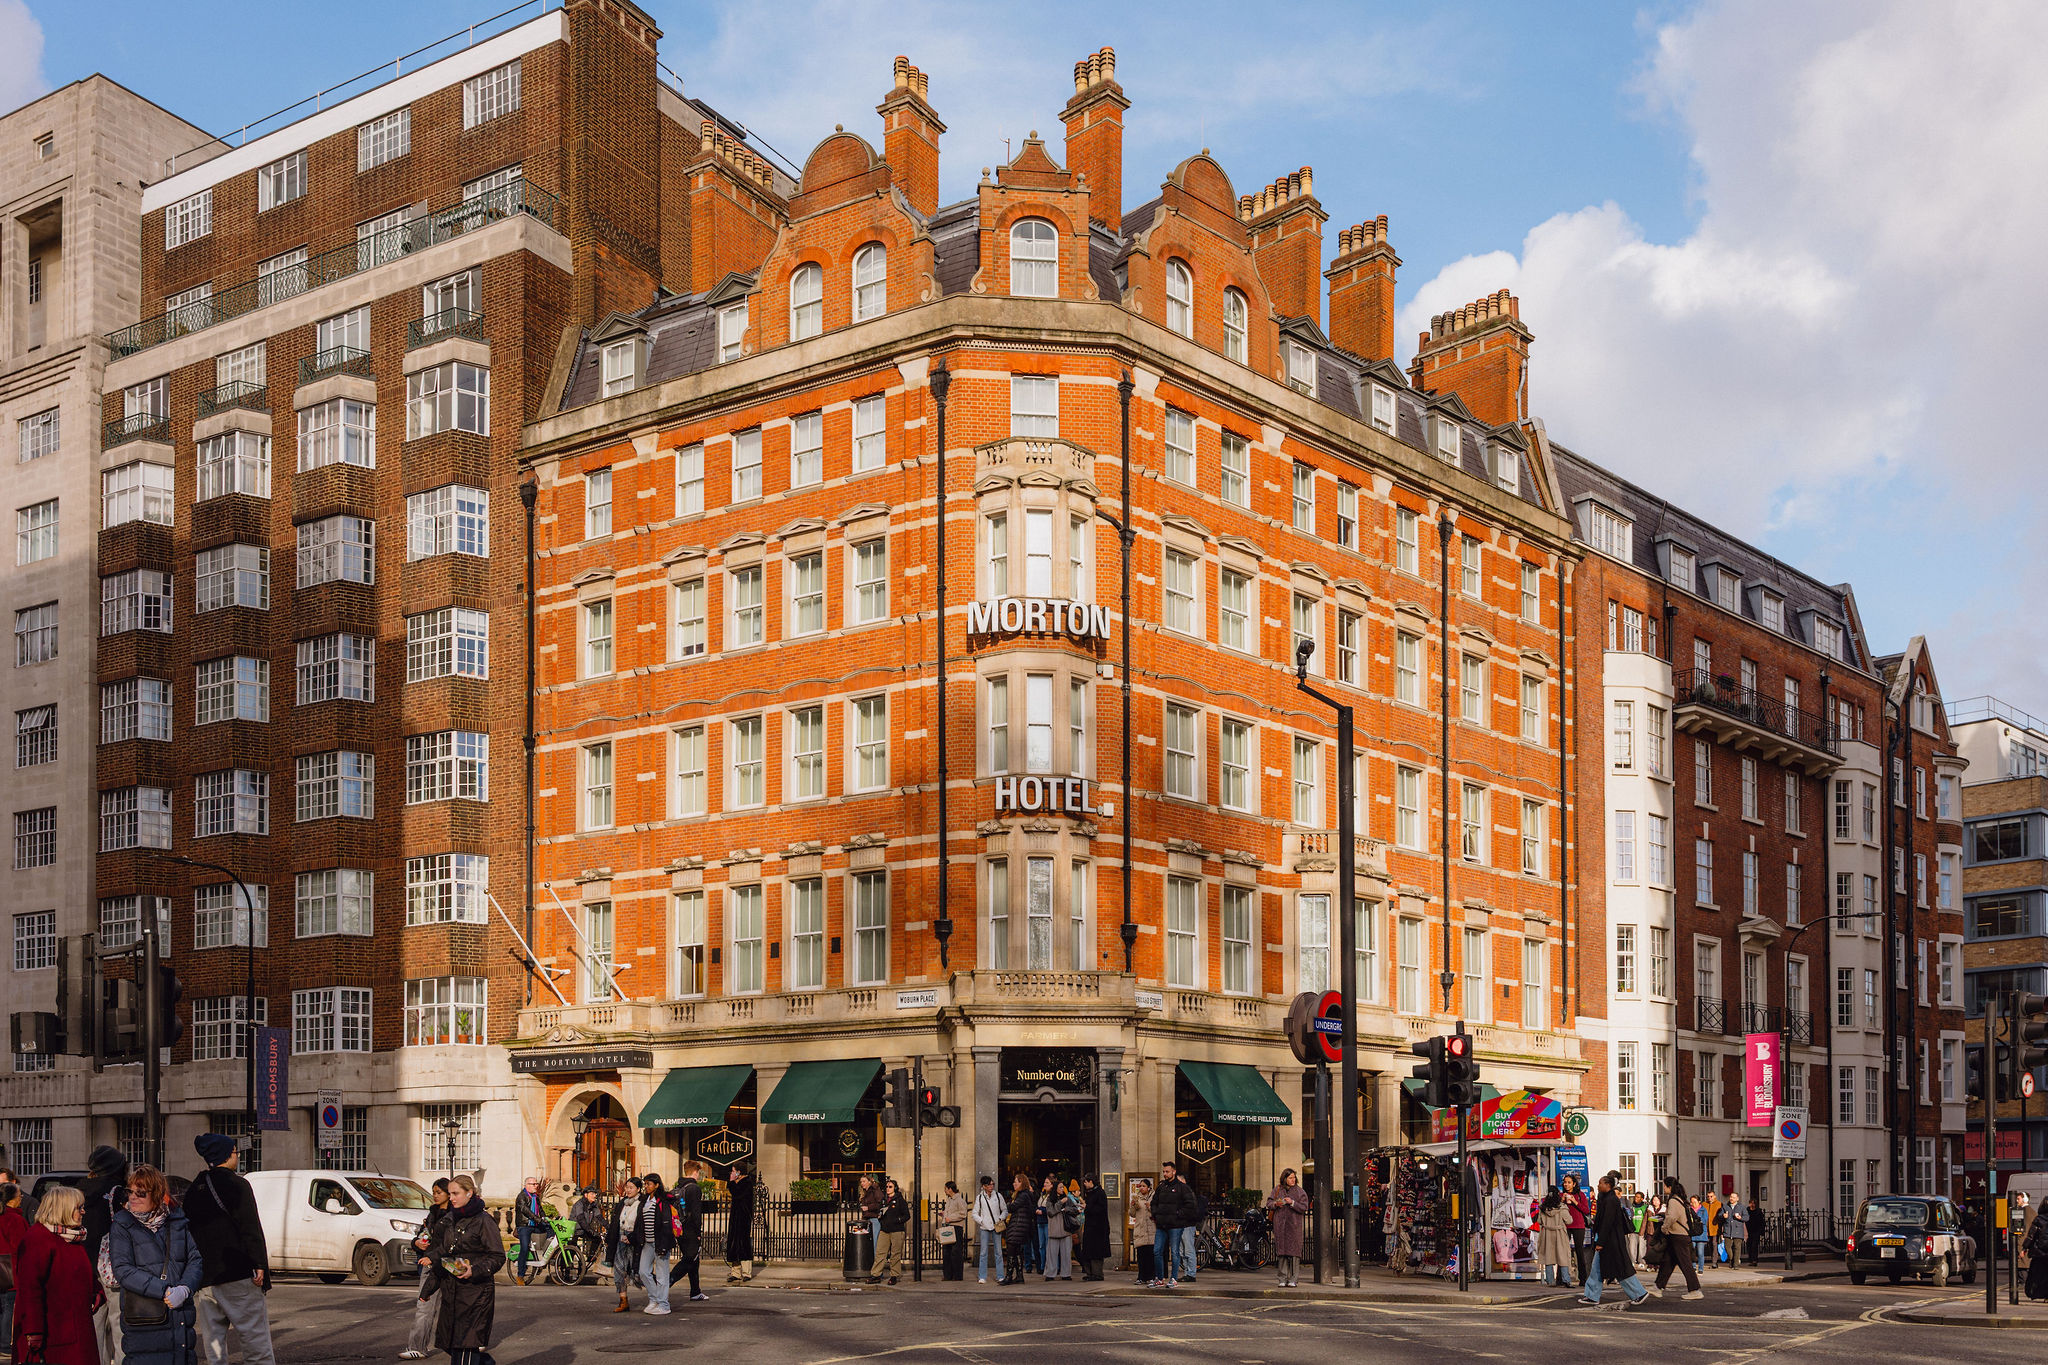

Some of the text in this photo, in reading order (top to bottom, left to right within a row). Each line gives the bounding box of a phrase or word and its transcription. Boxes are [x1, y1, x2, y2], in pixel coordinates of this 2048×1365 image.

[967, 599, 1111, 640] MORTON
[995, 776, 1097, 813] HOTEL
[1135, 996, 1149, 1004] ERNARD
[1315, 1020, 1342, 1031] UNDERGRO
[544, 1058, 584, 1067] MORTON
[591, 1056, 626, 1064] HOTEL
[1017, 1069, 1075, 1080] Number One
[1754, 1085, 1764, 1093] IS
[1763, 1063, 1773, 1109] BLOOMSBURY
[1755, 1093, 1764, 1109] THIS
[654, 1117, 708, 1125] @FARMERJFOOD
[1781, 1112, 1802, 1120] ZONE
[1487, 1120, 1520, 1128] TICKETS
